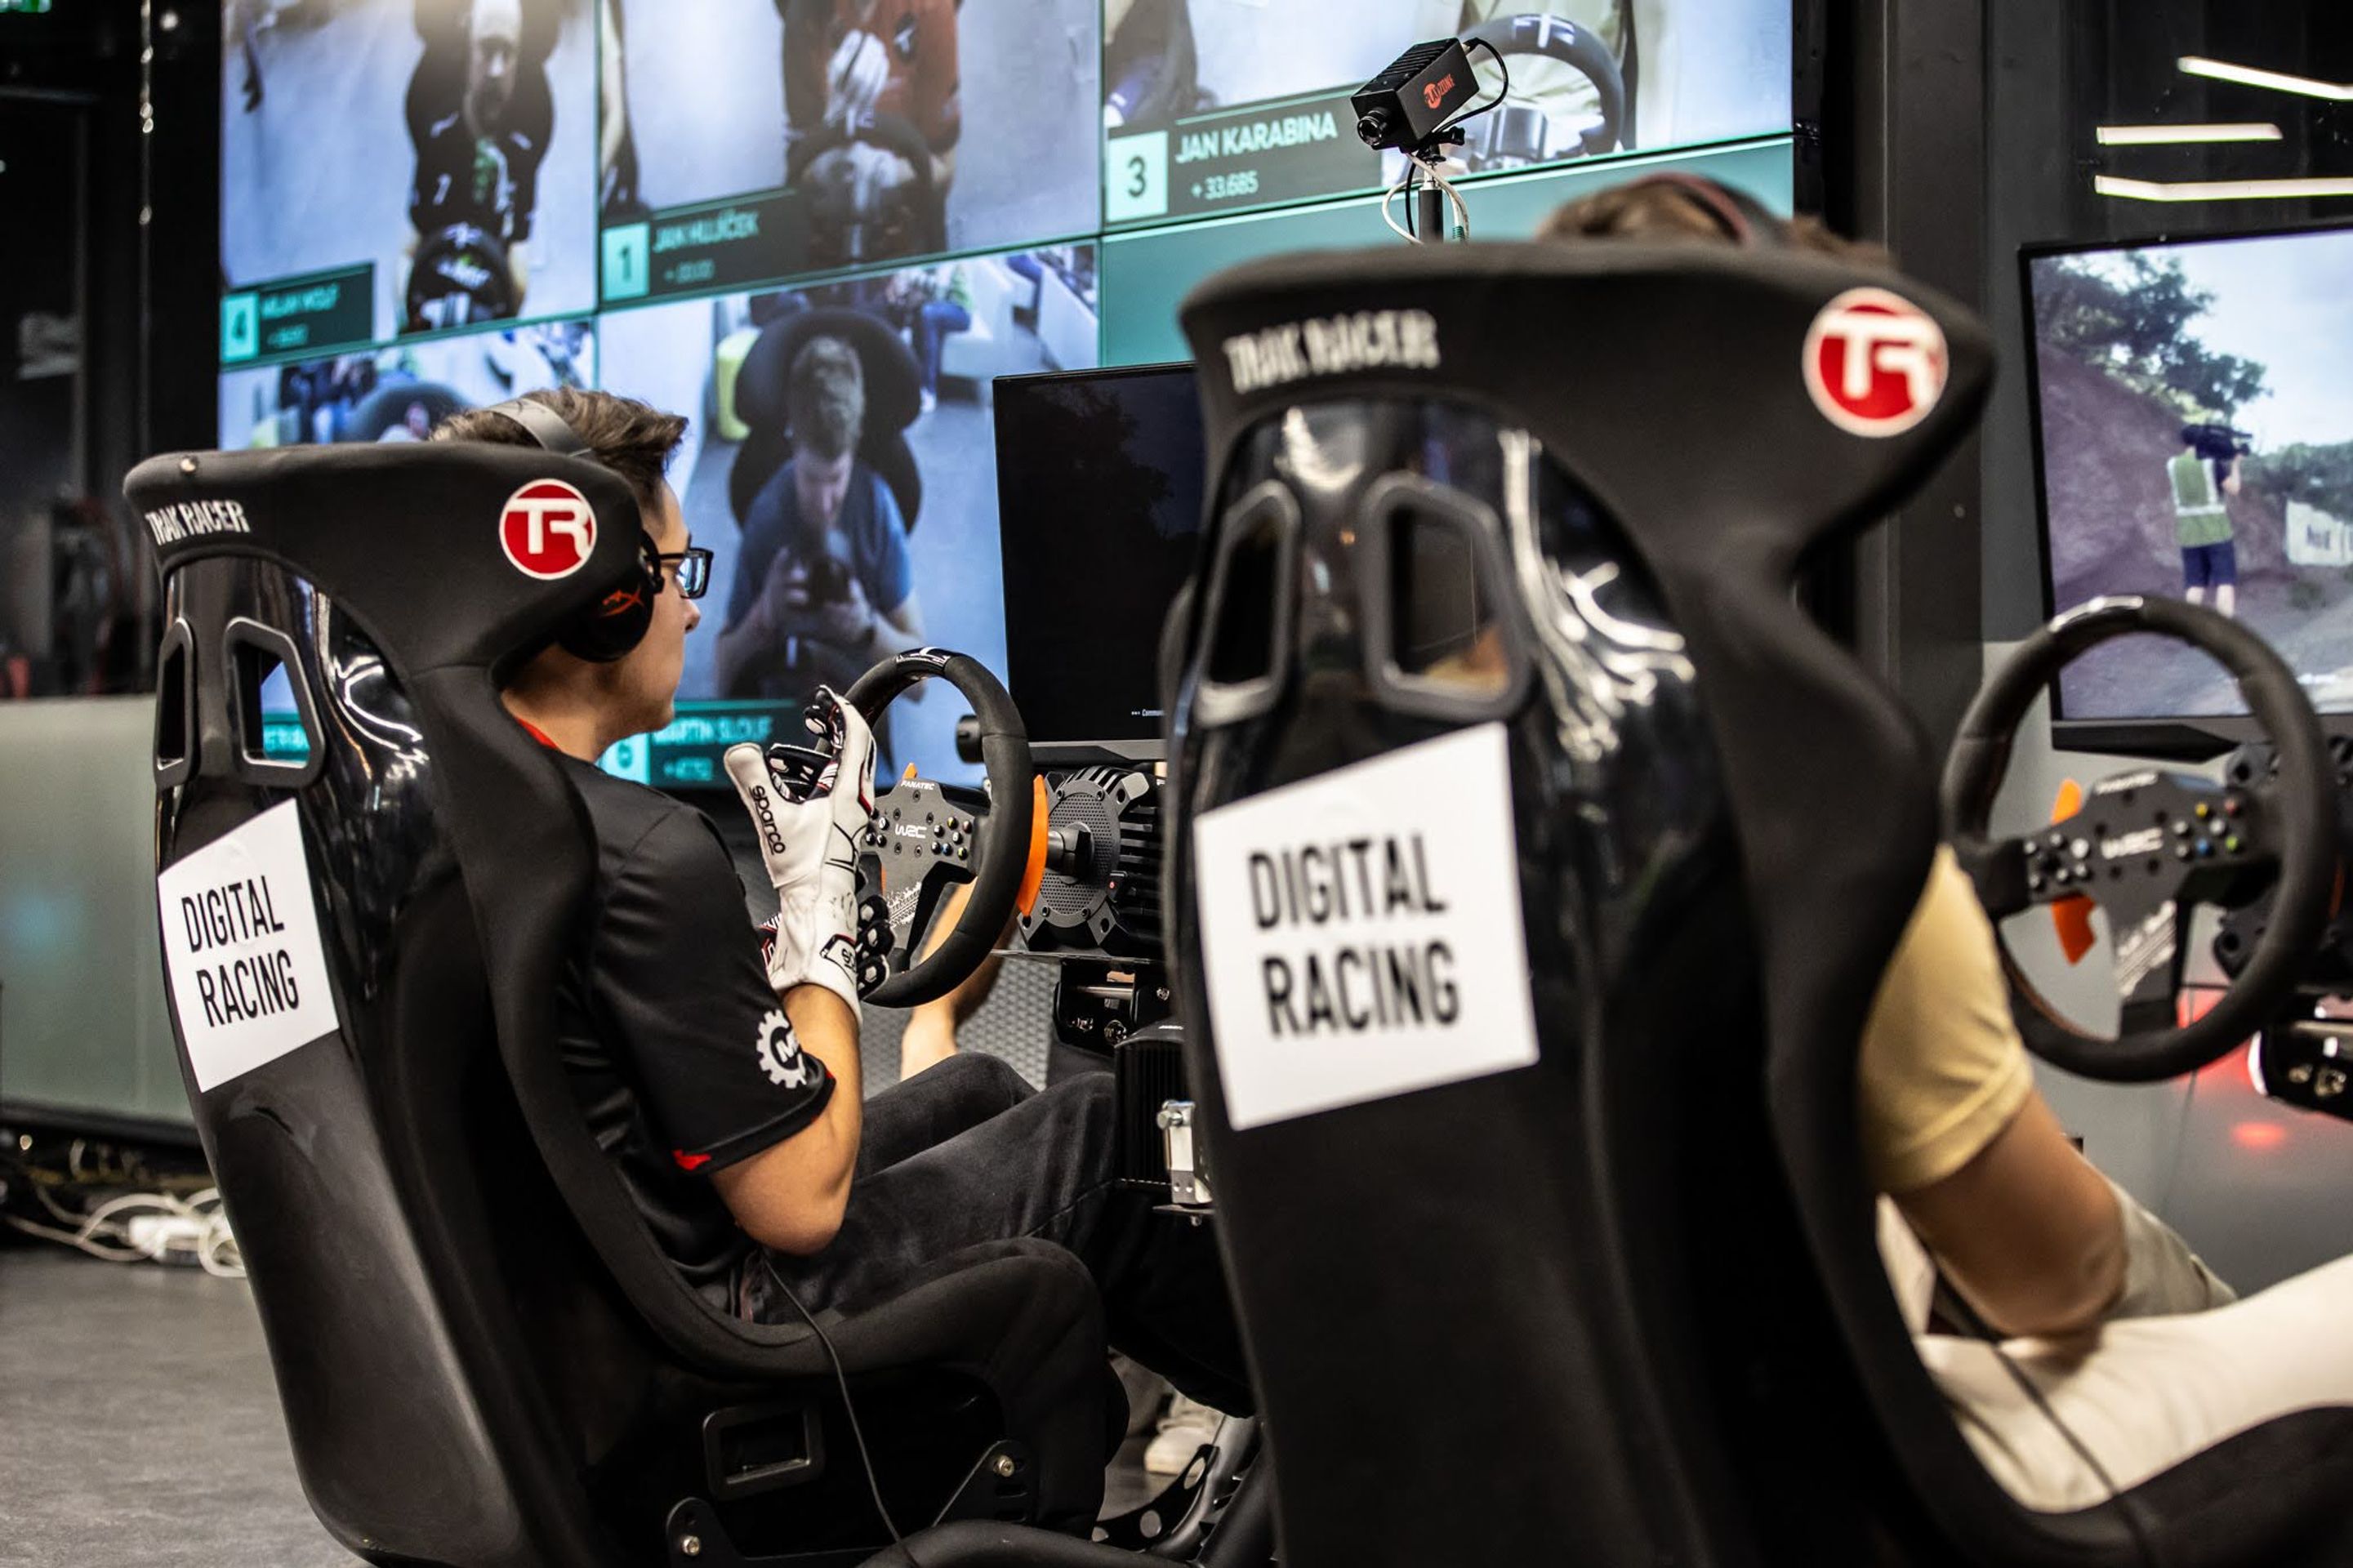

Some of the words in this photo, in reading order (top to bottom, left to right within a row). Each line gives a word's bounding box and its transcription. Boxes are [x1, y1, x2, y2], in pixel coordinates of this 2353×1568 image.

[1175, 131, 1219, 163] JAN
[1223, 111, 1338, 157] KARABINA
[1127, 156, 1146, 198] 3
[619, 243, 632, 283] 1
[145, 505, 188, 546] TRAK
[178, 499, 251, 535] RACER
[504, 493, 591, 564] TR
[900, 780, 935, 791] FANATEC
[751, 785, 786, 855] sparco
[894, 823, 927, 839] WRC
[1248, 830, 1449, 929] DIGITAL
[181, 875, 284, 953] DIGITAL
[196, 950, 300, 1027] RACING
[1261, 939, 1461, 1040] RACING
